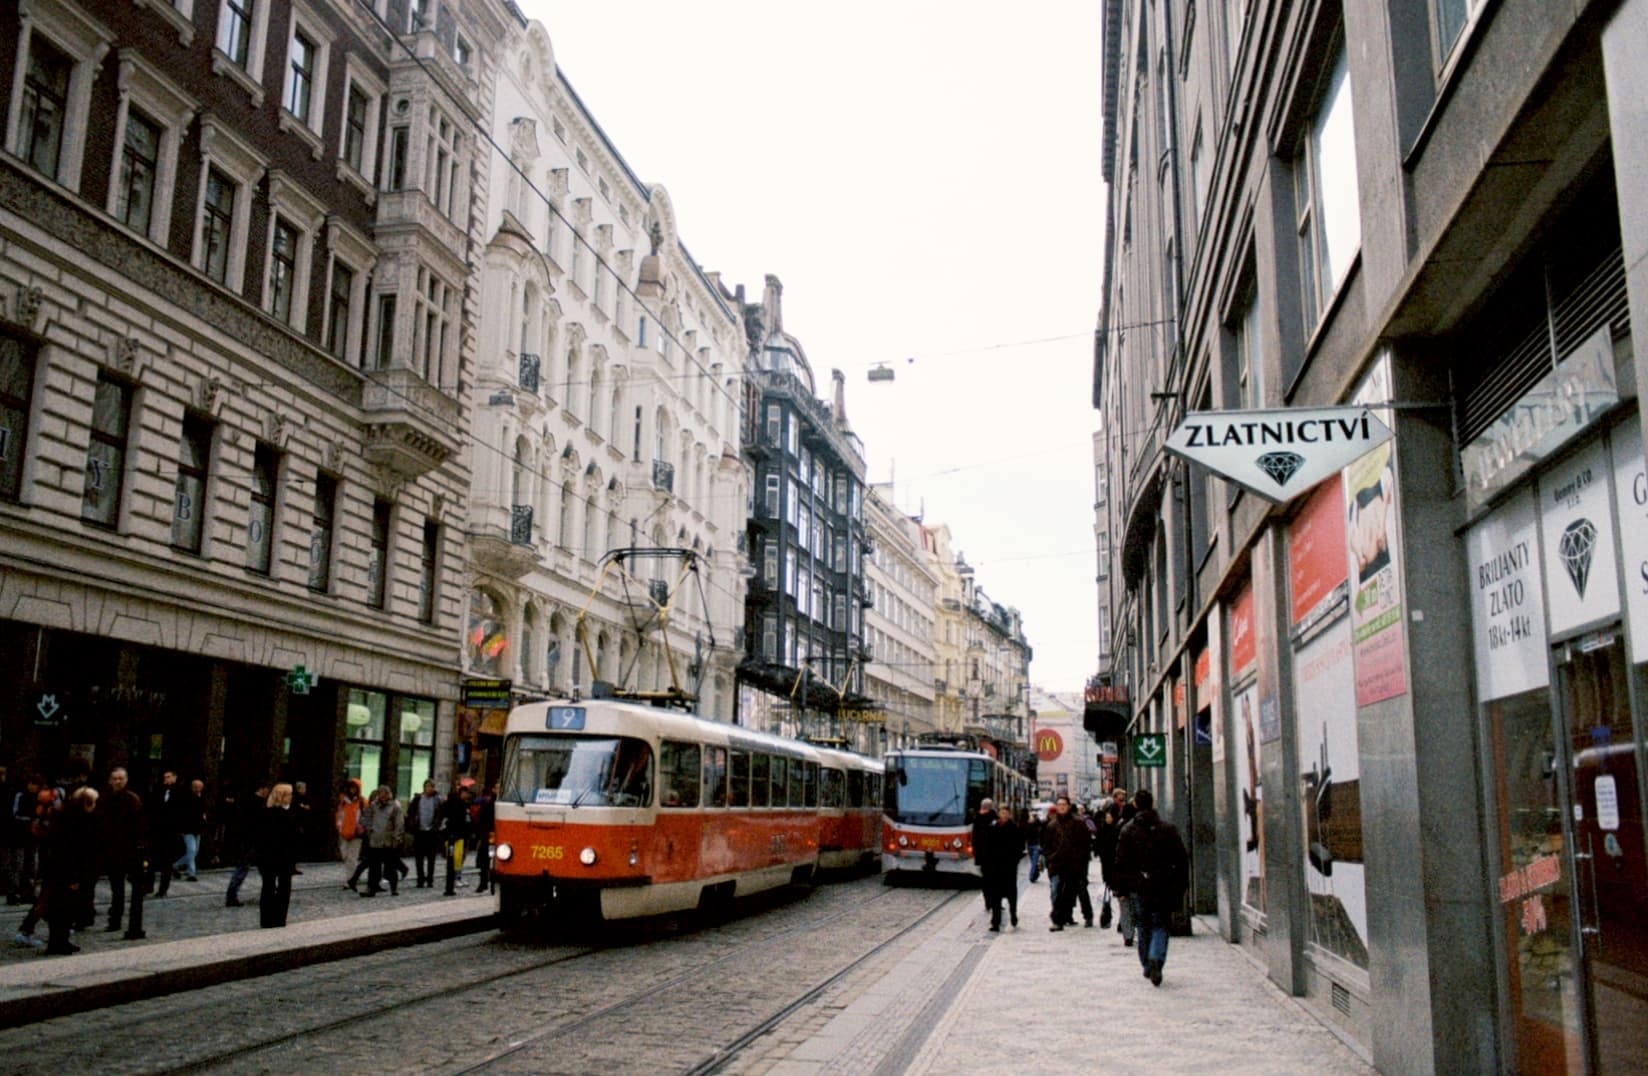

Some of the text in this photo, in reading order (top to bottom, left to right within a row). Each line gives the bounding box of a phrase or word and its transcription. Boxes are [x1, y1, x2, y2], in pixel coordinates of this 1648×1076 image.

[1185, 410, 1370, 448] ZLATNICTVÍ
[1478, 538, 1530, 589] BRILIANTY
[1489, 579, 1525, 618] ZLATO
[562, 707, 576, 728] 9
[530, 844, 564, 861] 7265
